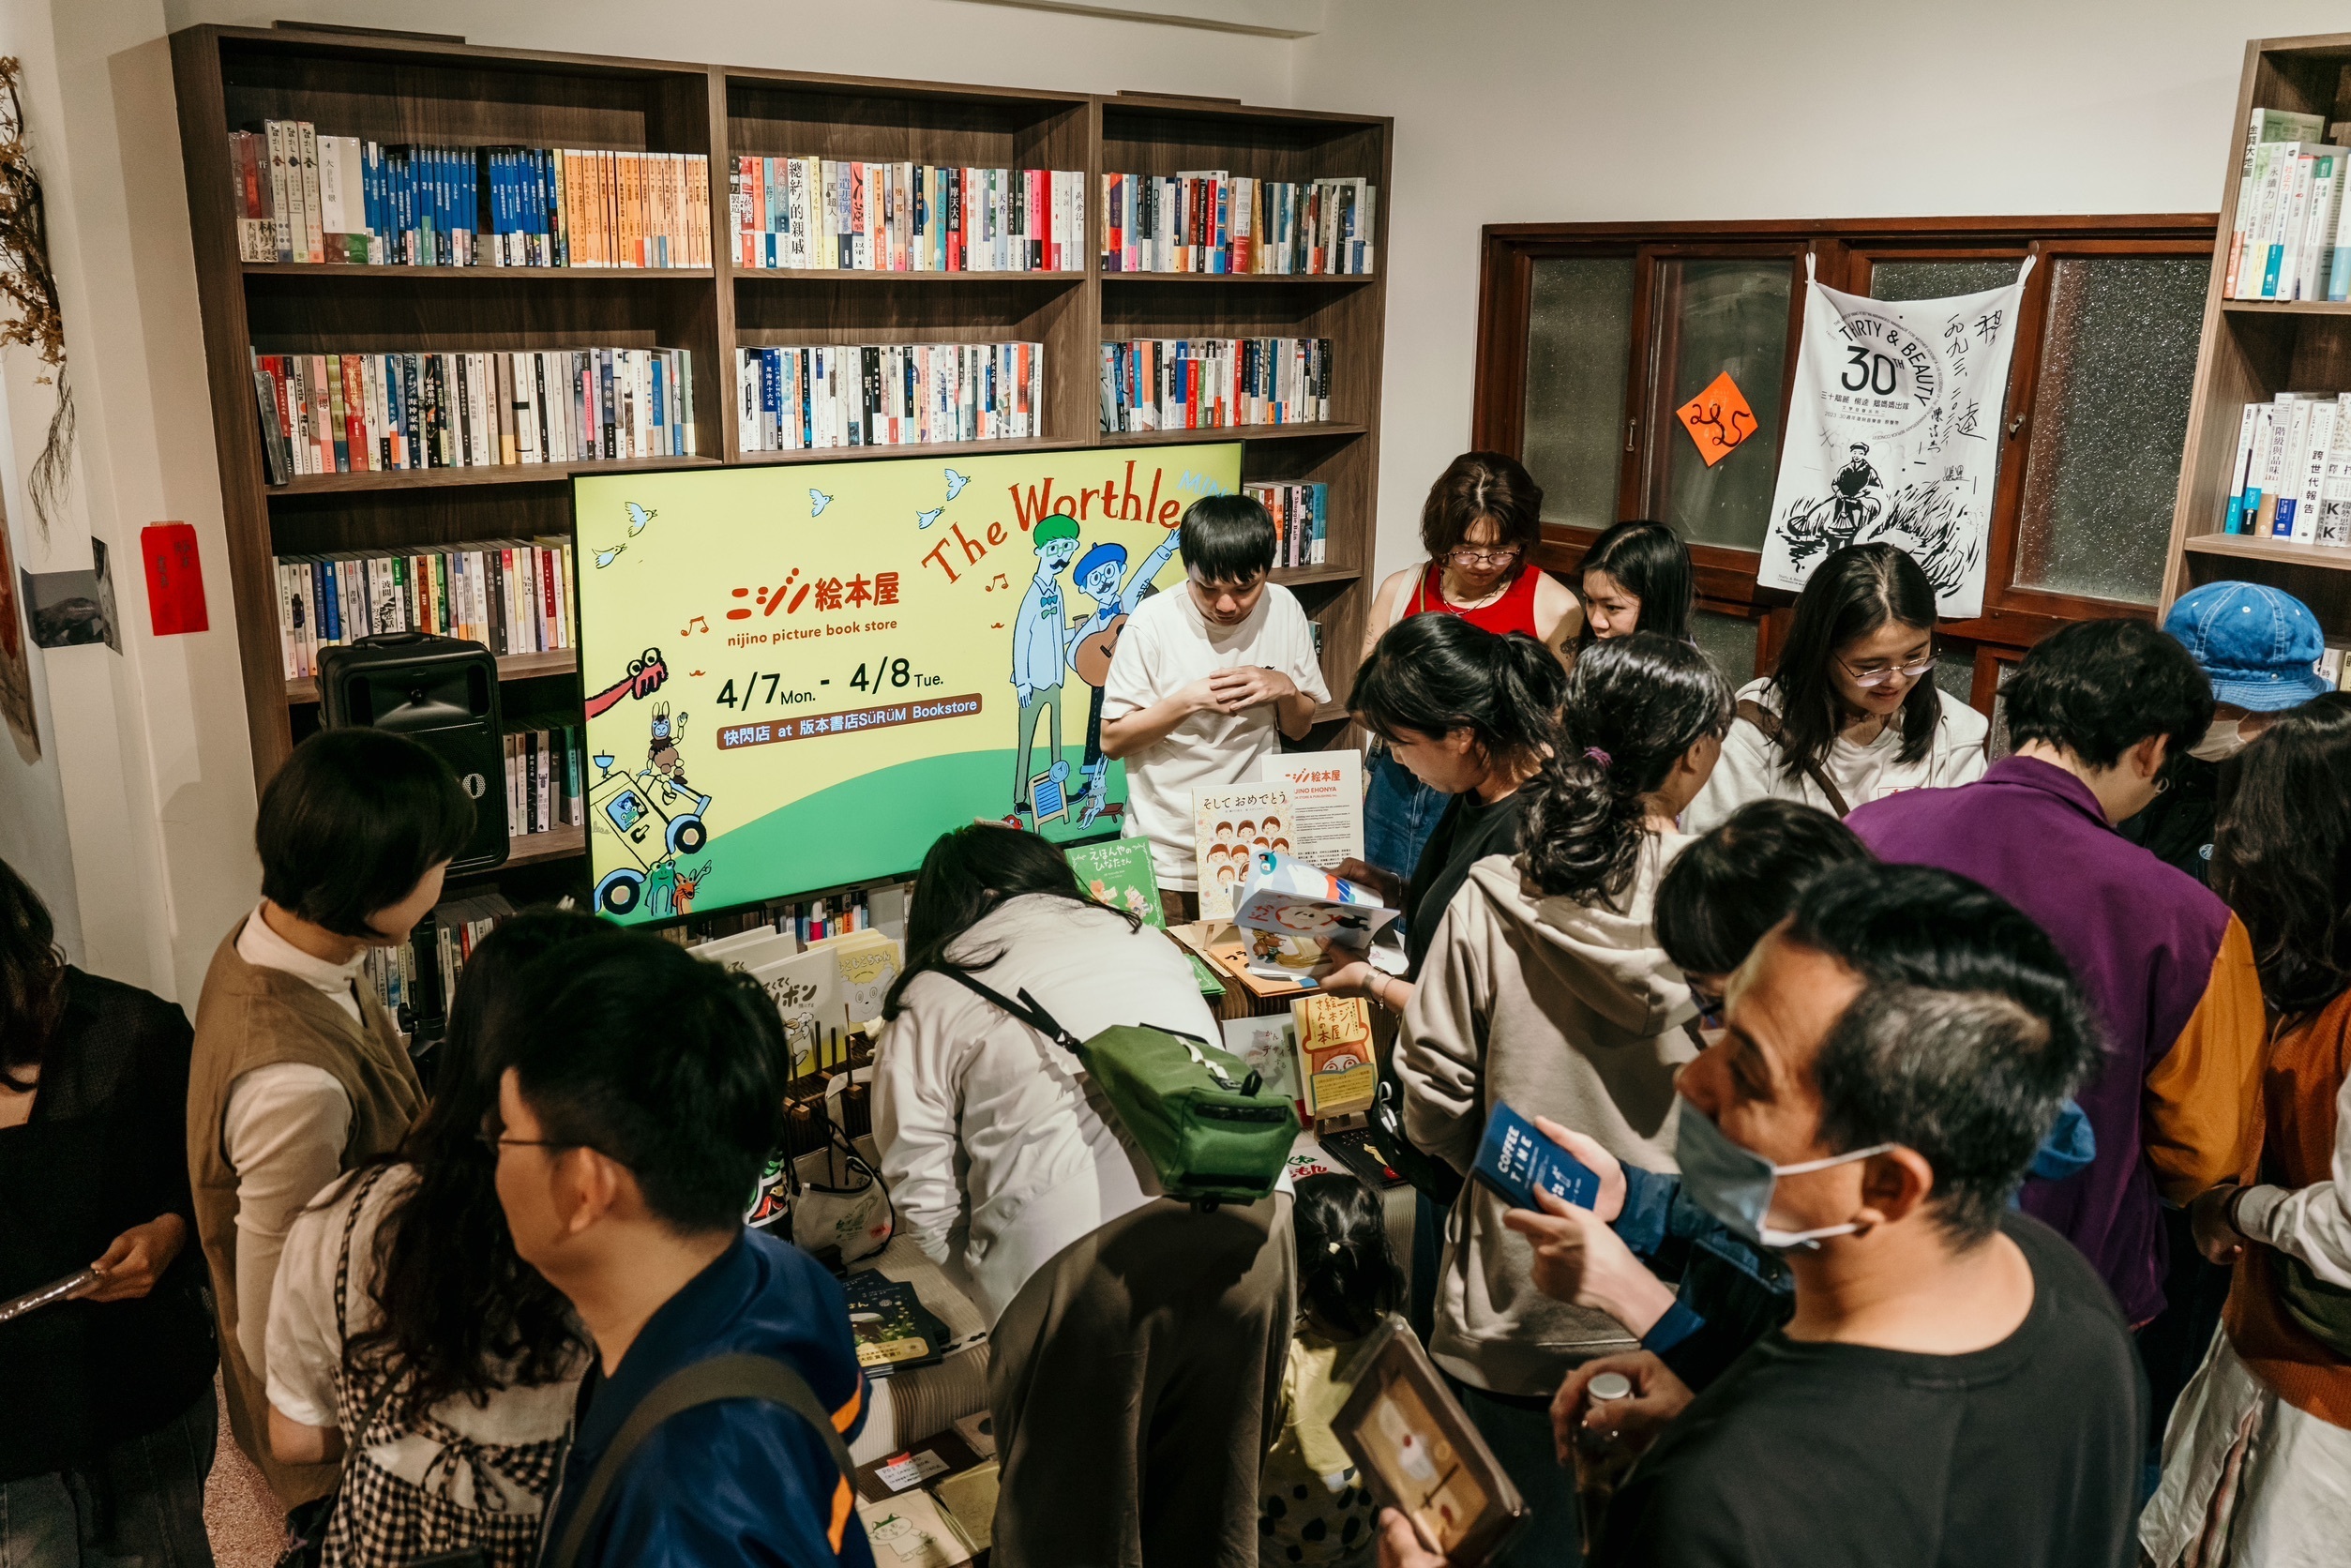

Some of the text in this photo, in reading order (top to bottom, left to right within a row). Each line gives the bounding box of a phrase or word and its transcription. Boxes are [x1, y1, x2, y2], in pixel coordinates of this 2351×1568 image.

[1887, 329, 1900, 346] &
[1901, 342, 1934, 407] BEAUTY
[604, 379, 613, 408] 流俗地
[2269, 426, 2286, 475] 階級與品味
[2303, 450, 2324, 514] 跨世代報告
[921, 521, 1008, 584] The
[726, 567, 899, 620] ニジノ絵本屋
[728, 620, 897, 648] nijino picture book store
[716, 671, 780, 711] 4/7
[781, 690, 816, 705] Mon.
[850, 656, 910, 694] 4/8
[914, 673, 943, 686] Tue.
[723, 725, 770, 746] 快閃店
[778, 724, 792, 738] at
[912, 700, 977, 718] Bookstore
[1203, 791, 1286, 809] そして おめでとう
[1090, 845, 1132, 861] えほんやの
[1094, 857, 1132, 871] ひなたさん
[1316, 999, 1332, 1045] さんの本
[1324, 998, 1341, 1041] 絵本屋
[1498, 1124, 1520, 1173] COFFEE
[1510, 1135, 1533, 1184] TIME
